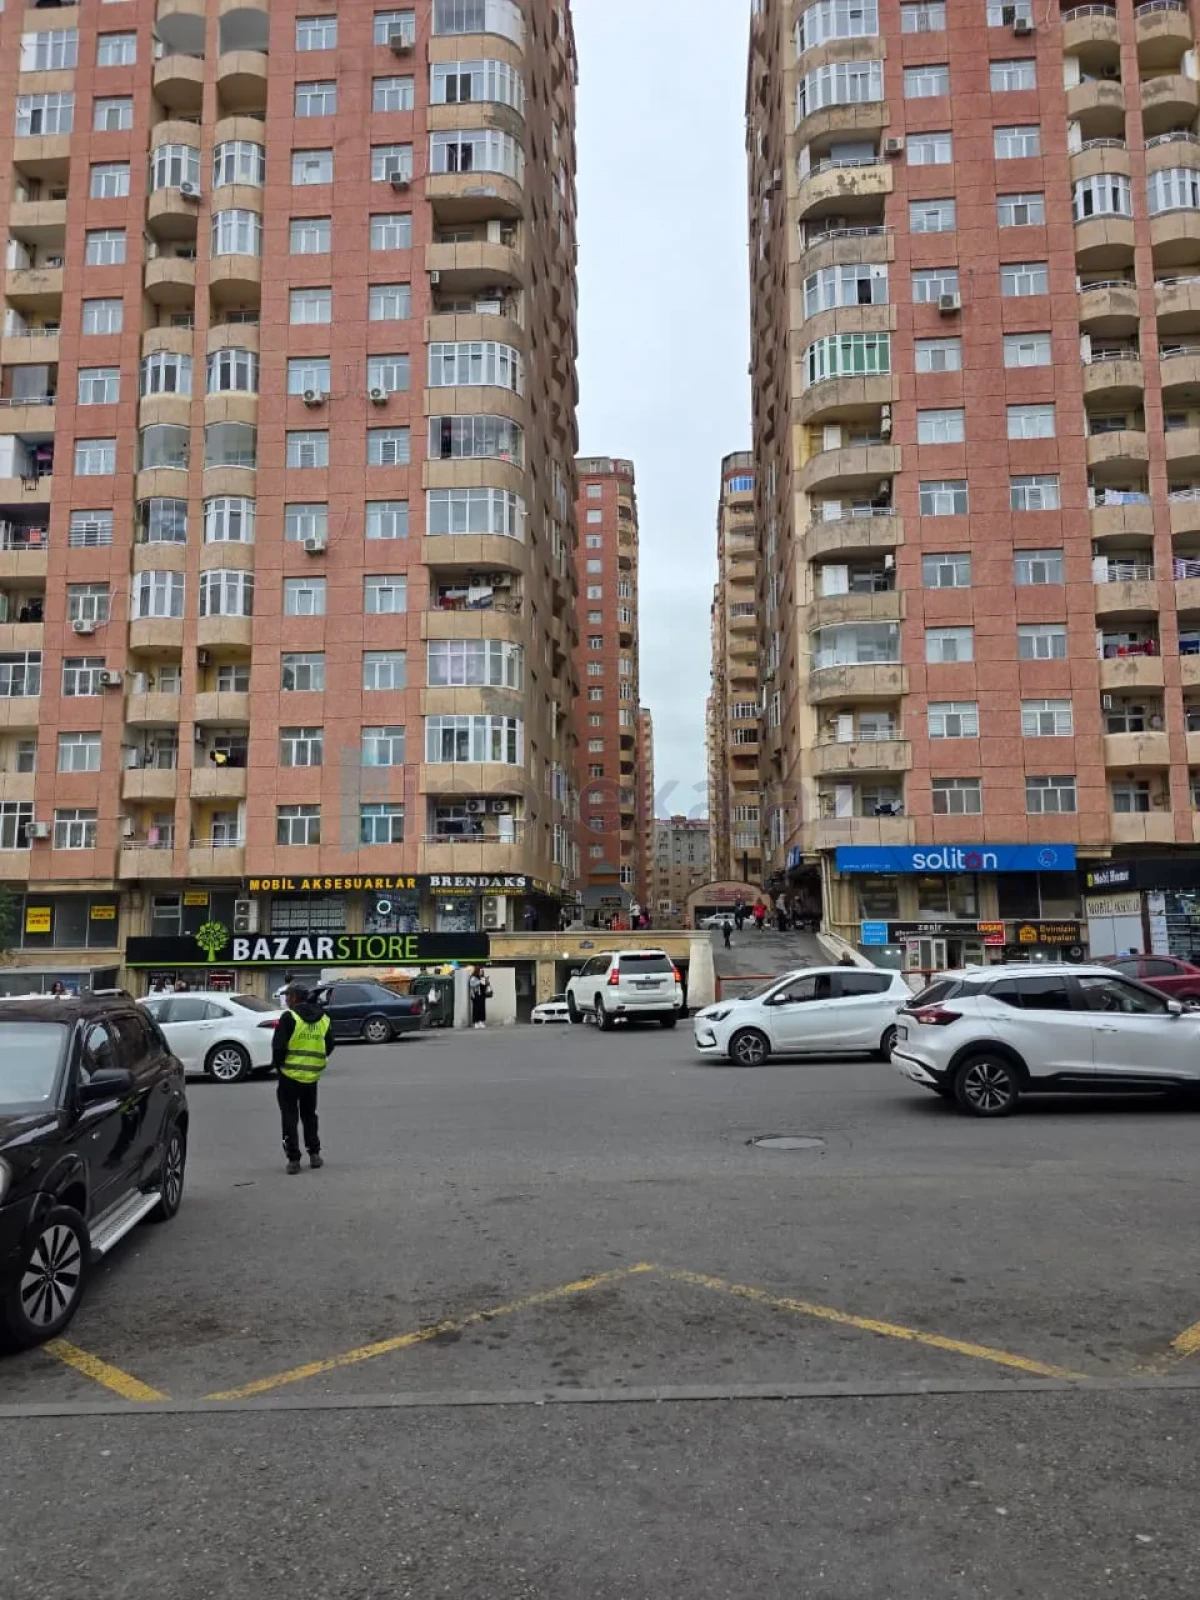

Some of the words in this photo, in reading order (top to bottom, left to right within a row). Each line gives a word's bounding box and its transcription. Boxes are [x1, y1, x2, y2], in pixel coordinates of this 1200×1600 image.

[912, 848, 998, 869] soliton
[250, 877, 295, 891] MOBİL
[302, 877, 415, 890] AKSESUARLAR
[430, 875, 526, 887] BRENDAKS
